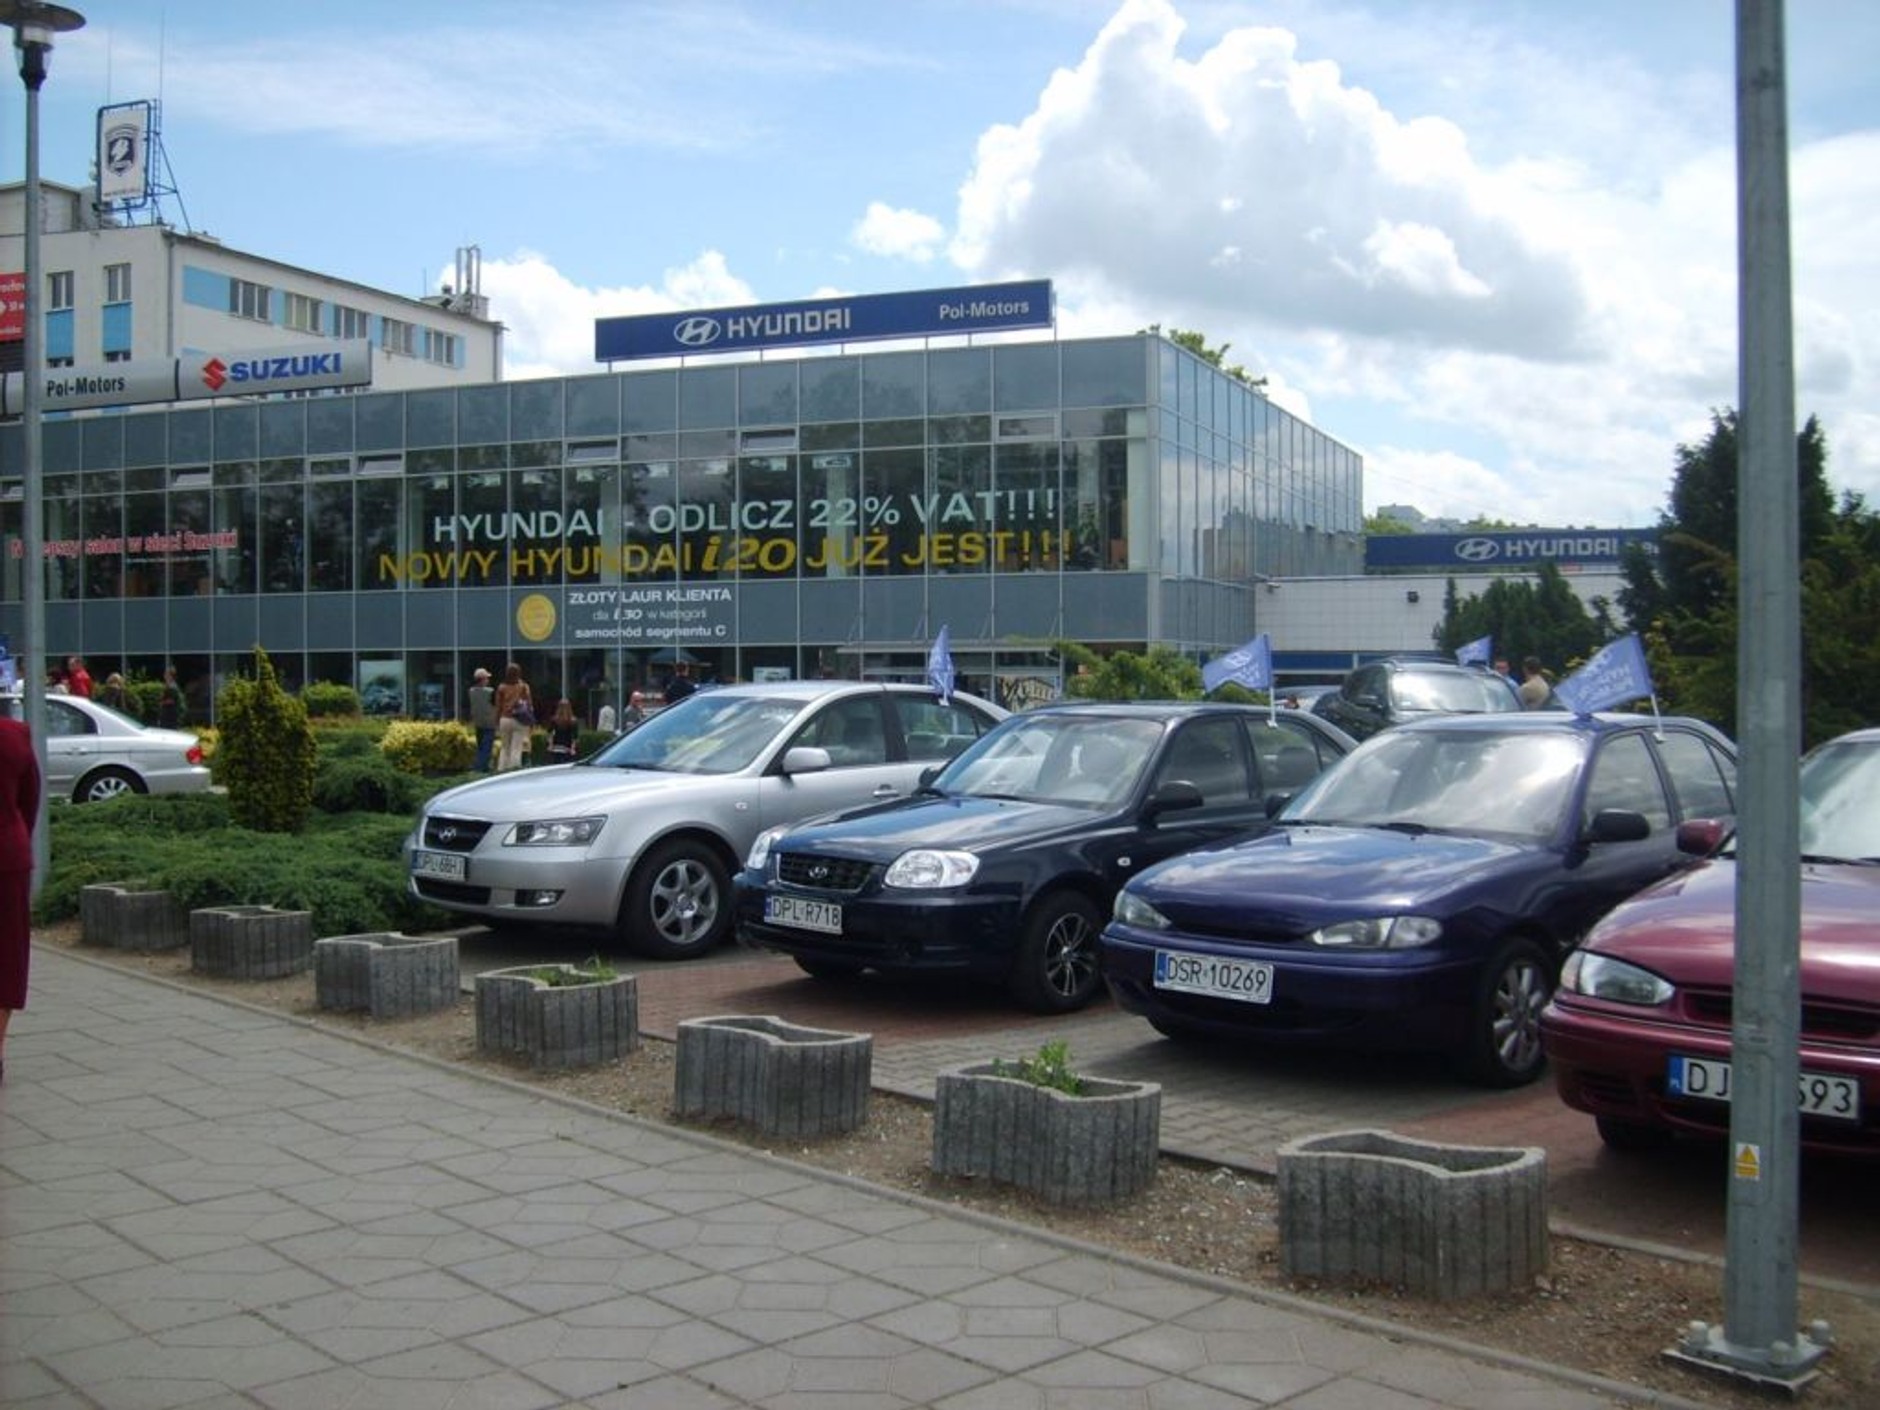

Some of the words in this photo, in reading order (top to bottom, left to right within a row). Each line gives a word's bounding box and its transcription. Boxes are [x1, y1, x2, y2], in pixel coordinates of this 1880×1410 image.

[939, 300, 1030, 320] Pol-Motors
[727, 308, 850, 339] HYUNDAI
[230, 353, 341, 382] SUZUKI
[47, 374, 125, 397] Pol-Motors
[434, 508, 603, 542] HYUNDAI
[649, 500, 794, 533] ODLICZ
[809, 495, 900, 528] 22%
[910, 489, 1054, 525] VAT!!!
[379, 550, 497, 582] NOWY
[511, 543, 691, 577] HYUNDAI
[702, 534, 797, 572] i20
[806, 527, 889, 567] JUŻ
[902, 529, 1071, 566] JEST!!!
[1505, 537, 1618, 558] HYUNDAI
[569, 591, 619, 605] ZŁOTY
[621, 590, 663, 602] LAUR
[666, 588, 732, 602] KLIENTA
[575, 626, 642, 639] samochód
[715, 625, 727, 636] C
[1210, 963, 1267, 993] 10269
